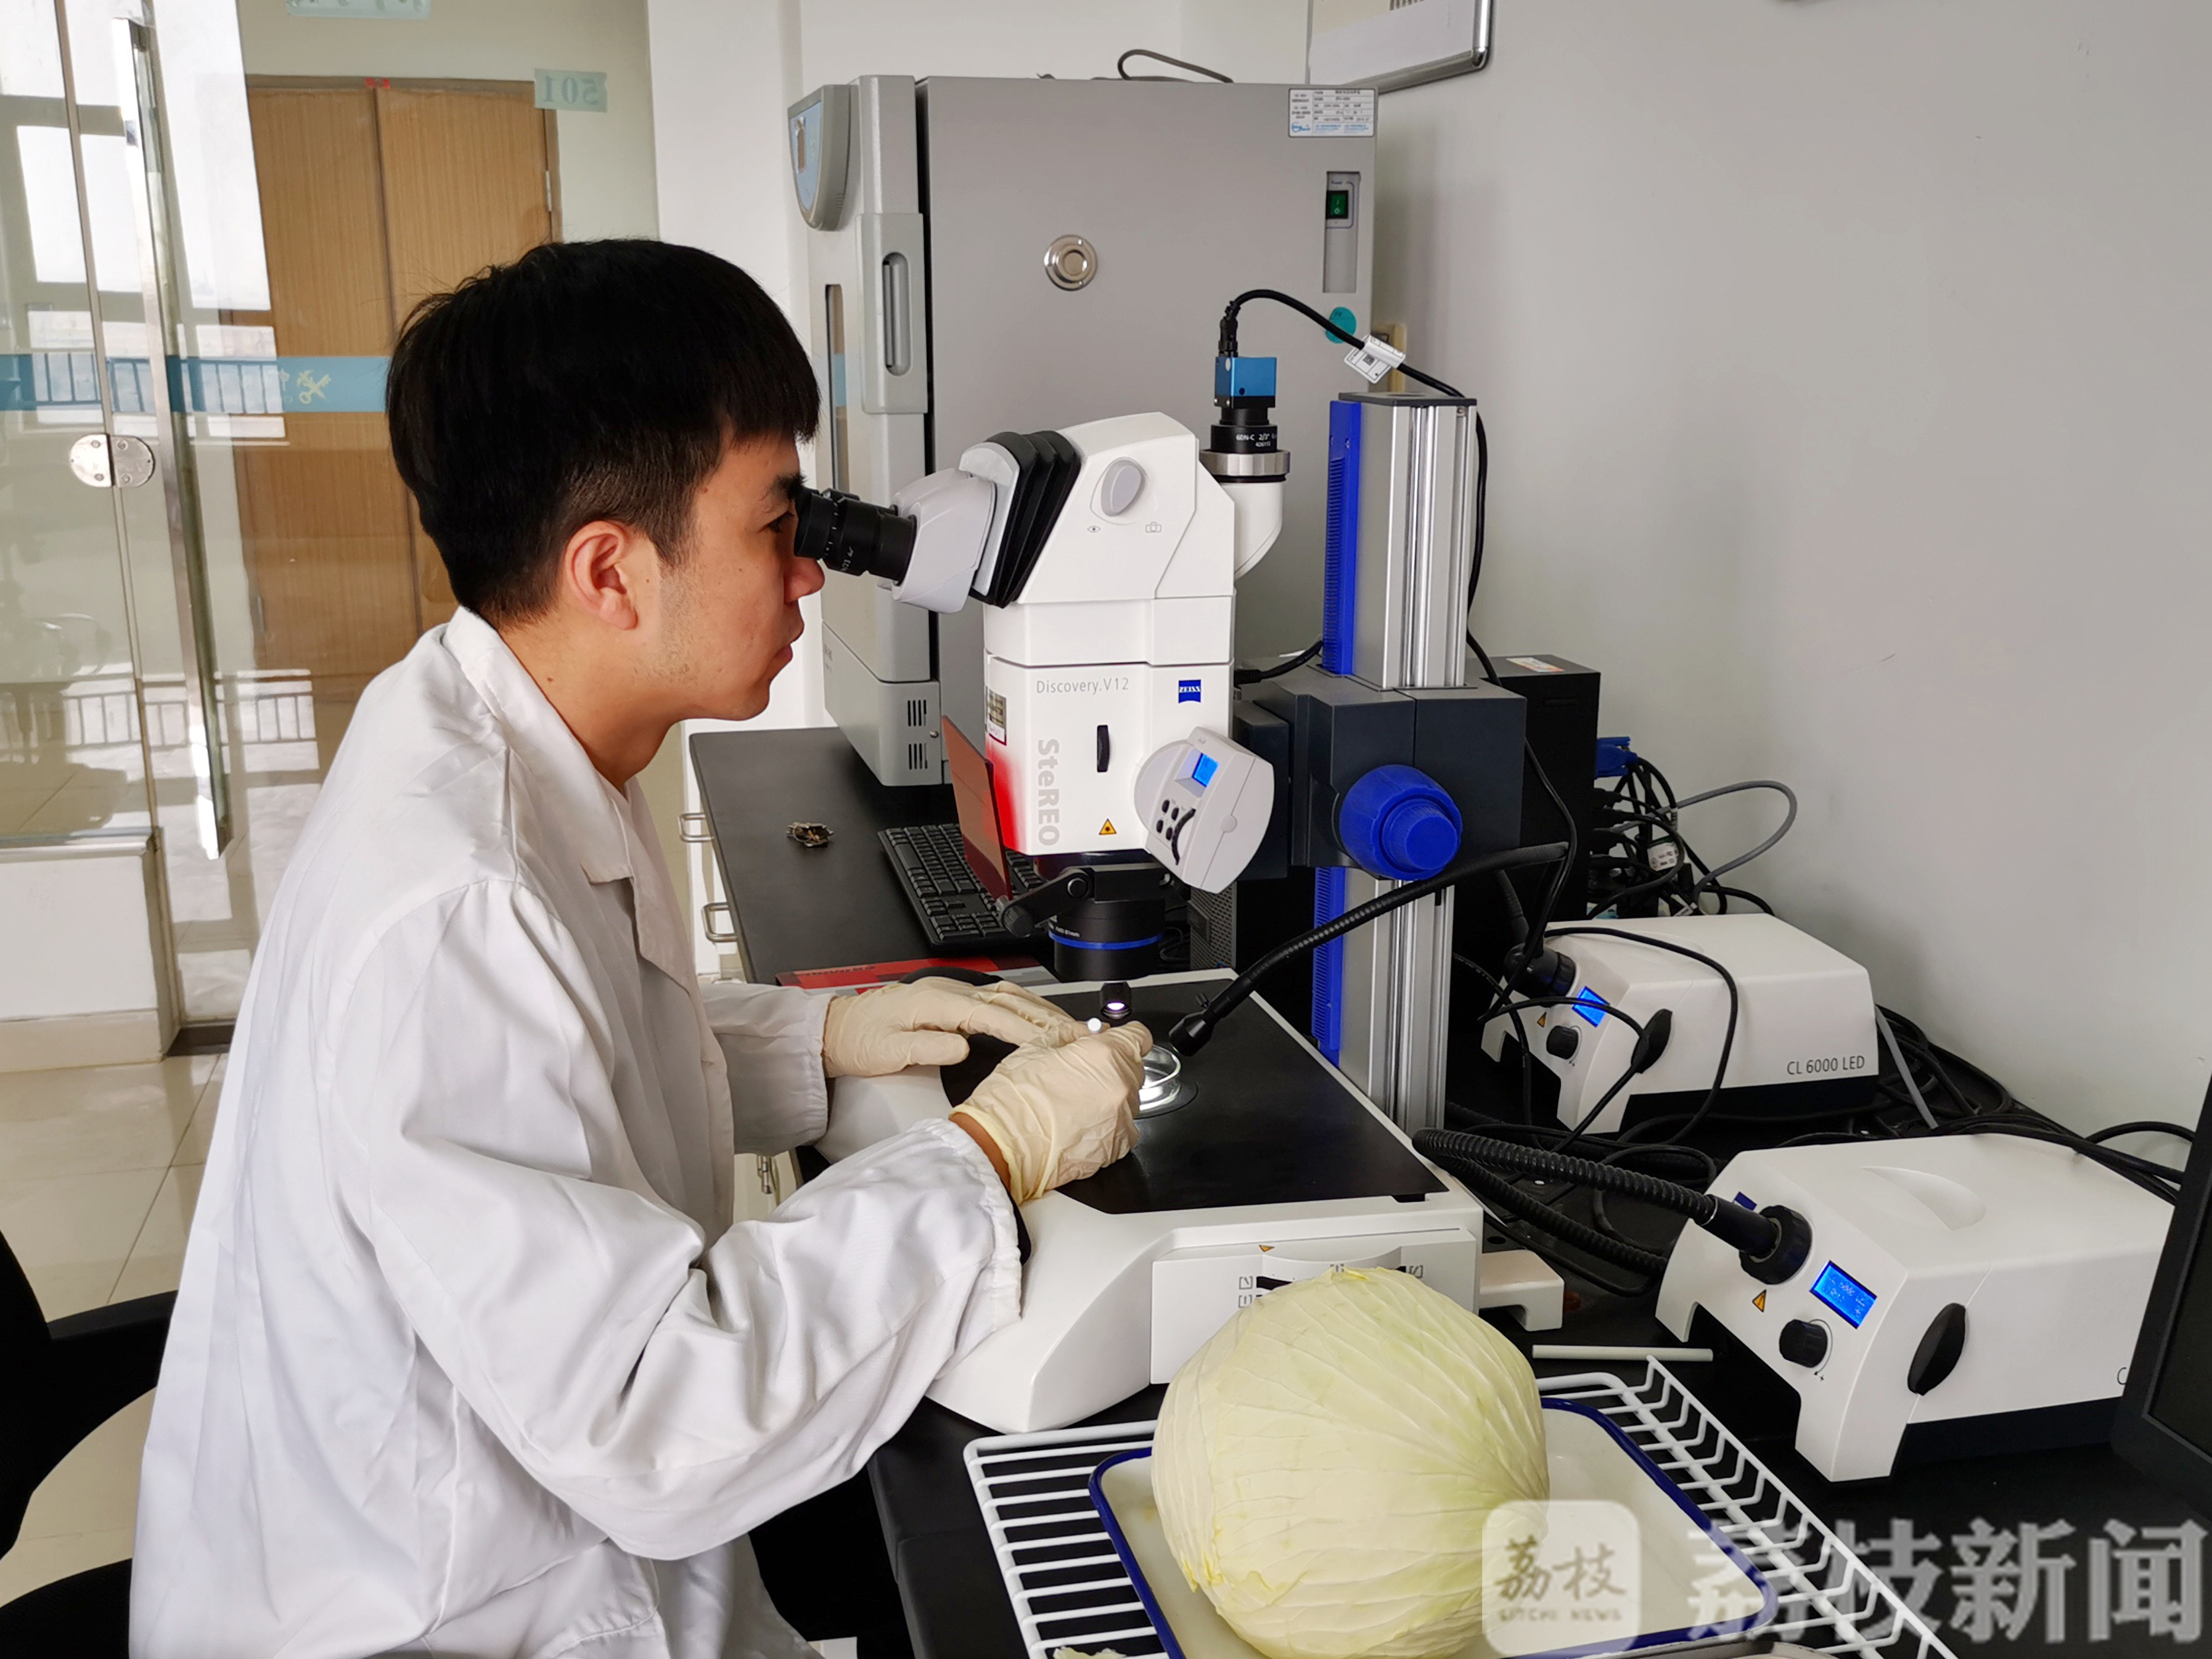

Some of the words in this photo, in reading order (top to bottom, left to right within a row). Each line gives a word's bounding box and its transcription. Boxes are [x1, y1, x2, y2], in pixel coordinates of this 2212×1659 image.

[1036, 677, 1129, 695] Discovery.V12
[1038, 739, 1060, 846] SteREO
[1787, 1061, 1802, 1075] CL
[1806, 1058, 1838, 1074] 6000
[1842, 1055, 1865, 1070] LED
